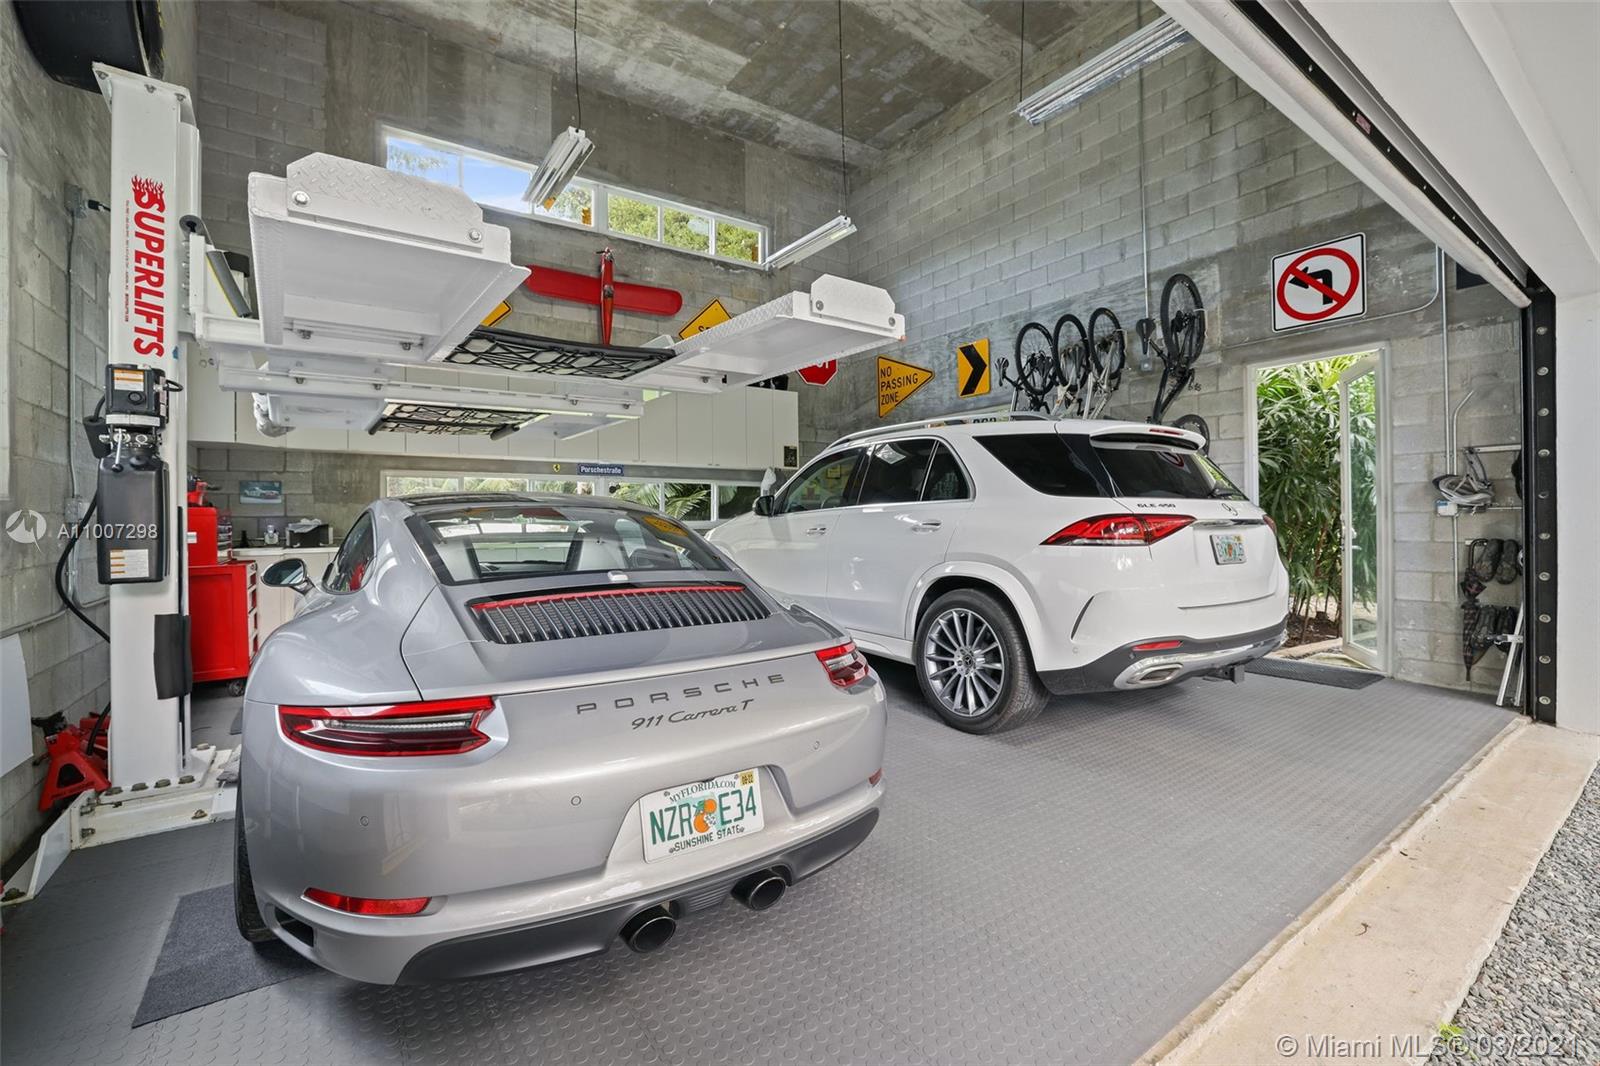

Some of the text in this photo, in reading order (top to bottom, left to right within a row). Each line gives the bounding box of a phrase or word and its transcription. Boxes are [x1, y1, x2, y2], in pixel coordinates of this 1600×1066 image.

[131, 175, 166, 358] SUPERLIFTS
[880, 366, 892, 379] NO
[880, 372, 919, 392] PASSING
[880, 391, 899, 406] ZONE
[580, 465, 622, 475] Porschestraße
[576, 673, 785, 715] PORSCHE
[631, 698, 755, 730] 911 Carrera T
[649, 785, 757, 845] NZR E34
[674, 824, 741, 852] SUNSHINE STATE
